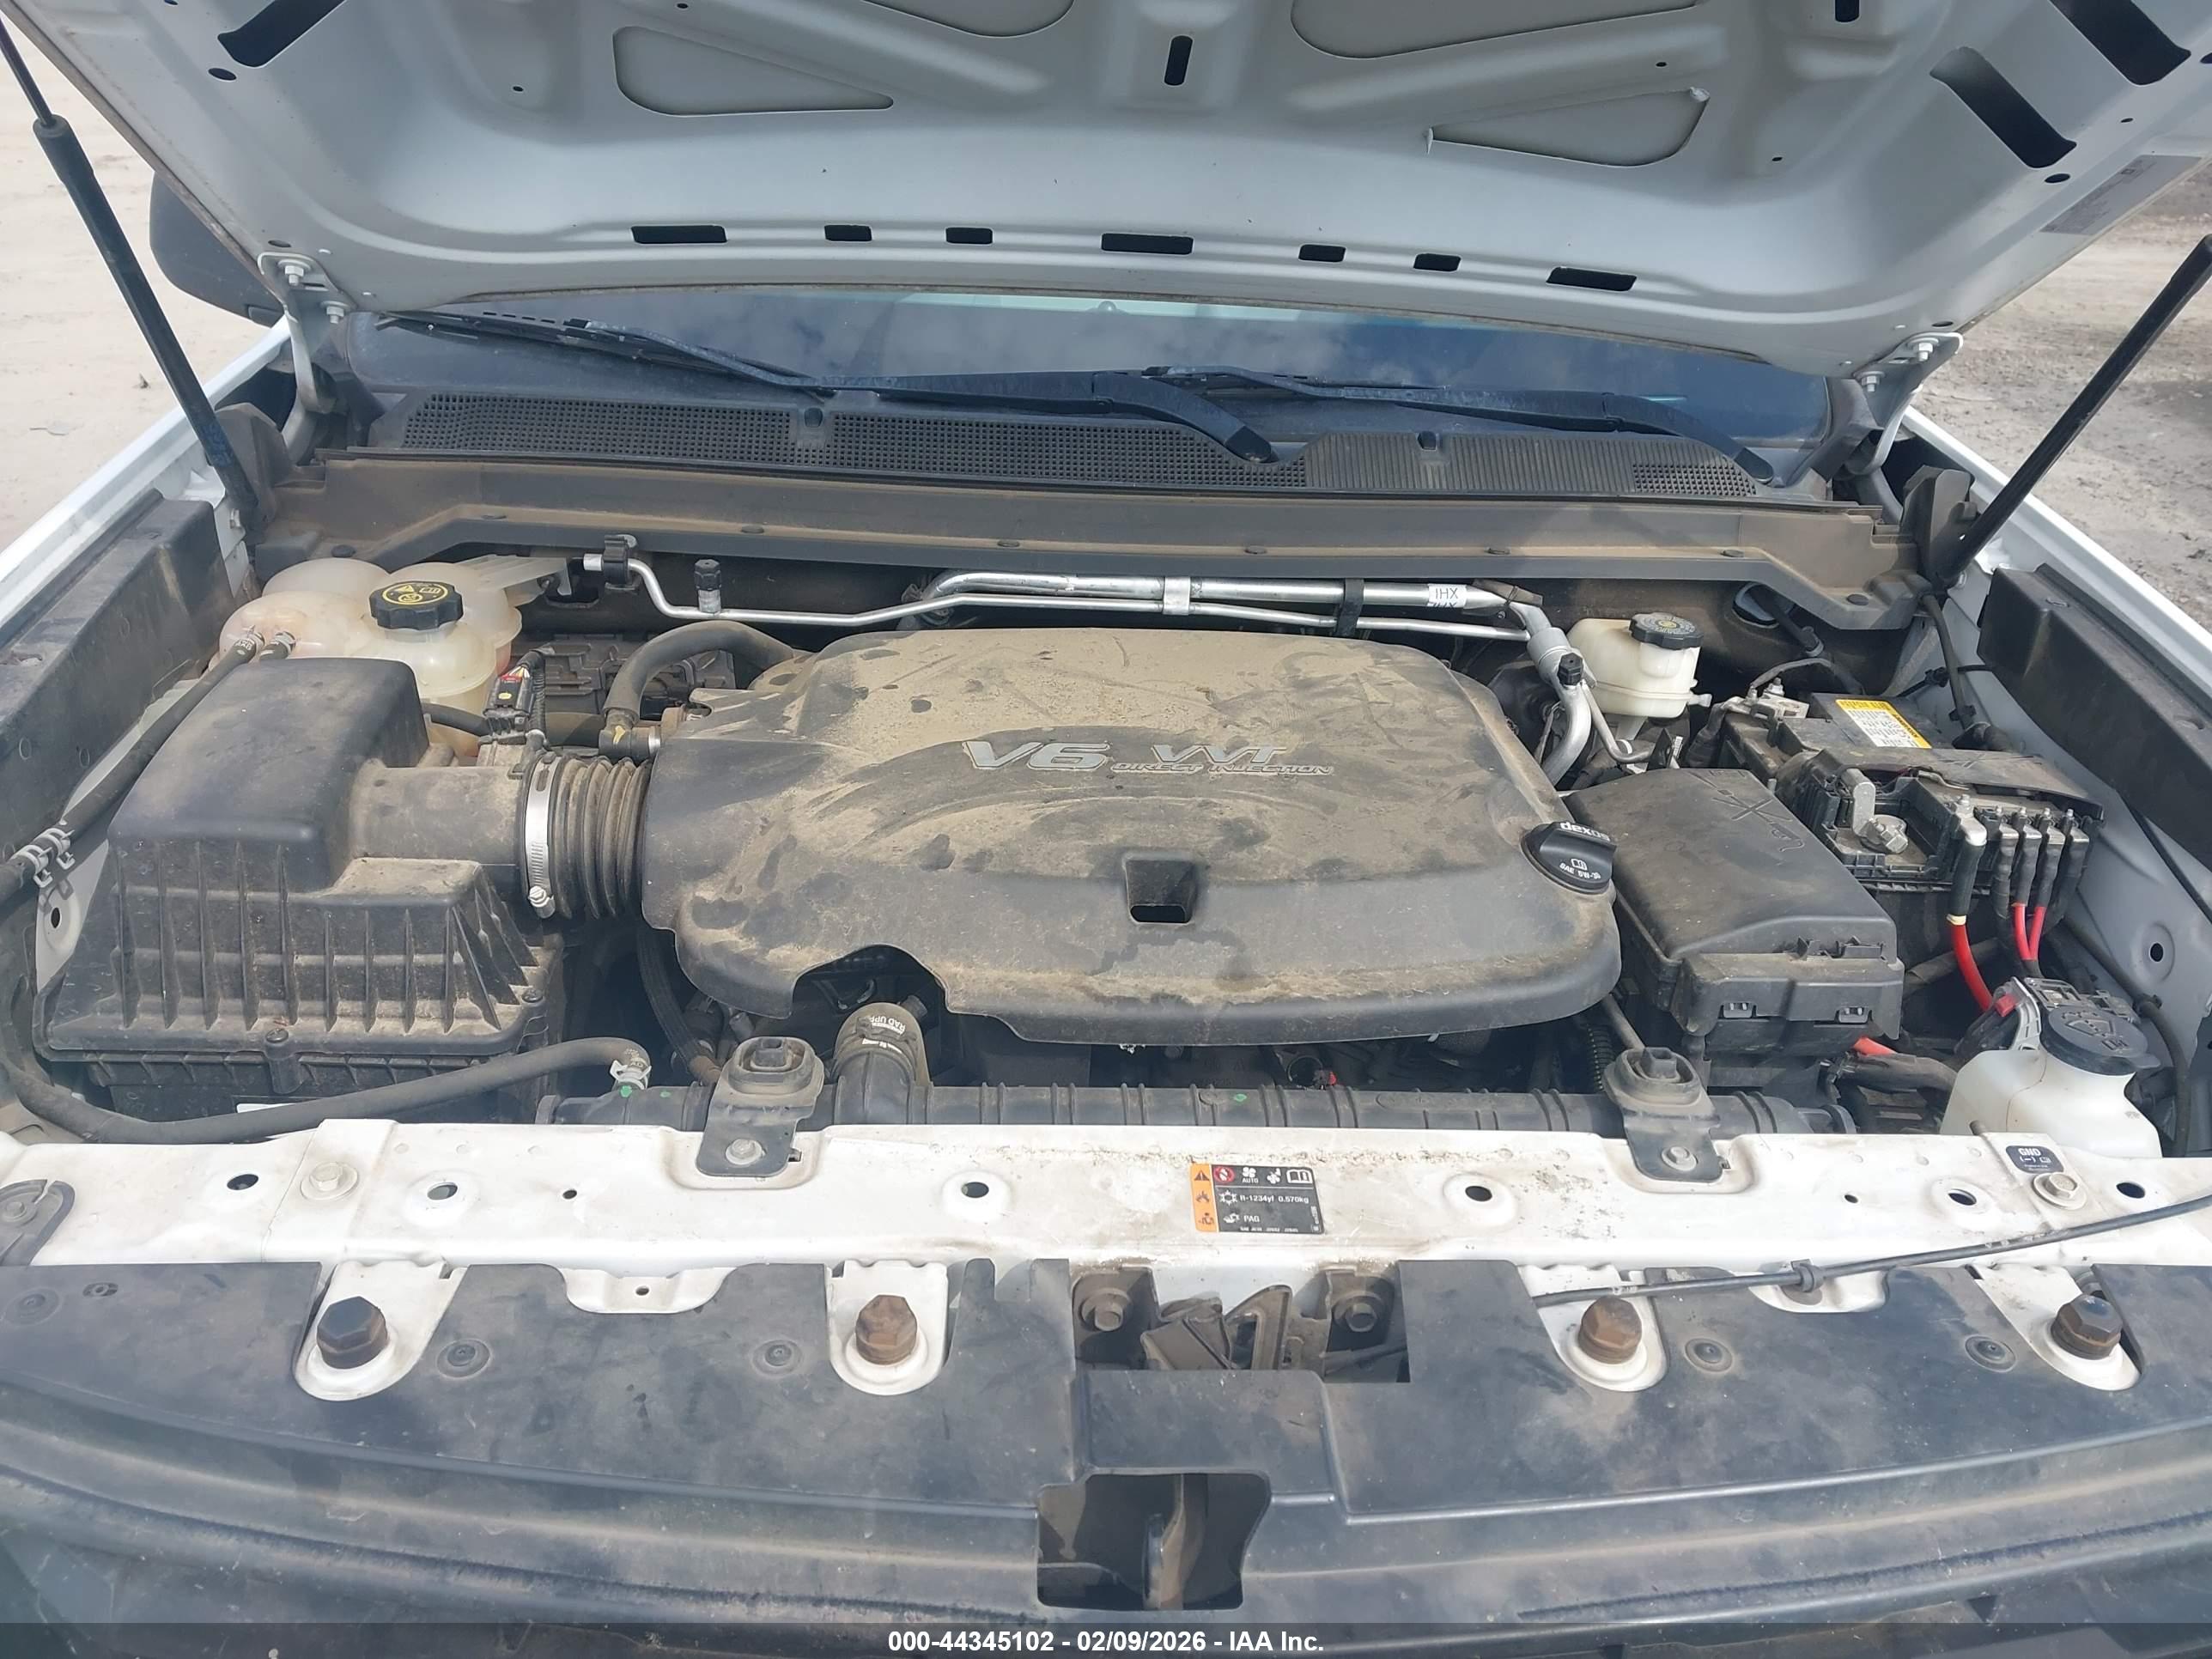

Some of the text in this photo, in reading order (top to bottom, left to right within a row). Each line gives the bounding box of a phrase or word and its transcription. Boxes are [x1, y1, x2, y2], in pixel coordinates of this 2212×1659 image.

[1435, 587, 1459, 599] IHX
[962, 740, 1287, 770] V6 VVT
[1112, 762, 1335, 775] DIRECT INJECTION
[1559, 822, 1610, 842] dexos
[1559, 862, 1575, 874] SAE
[888, 1018, 906, 1032] RAD
[2018, 1147, 2041, 1157] GND
[1278, 1195, 1310, 1204] 0.570kg
